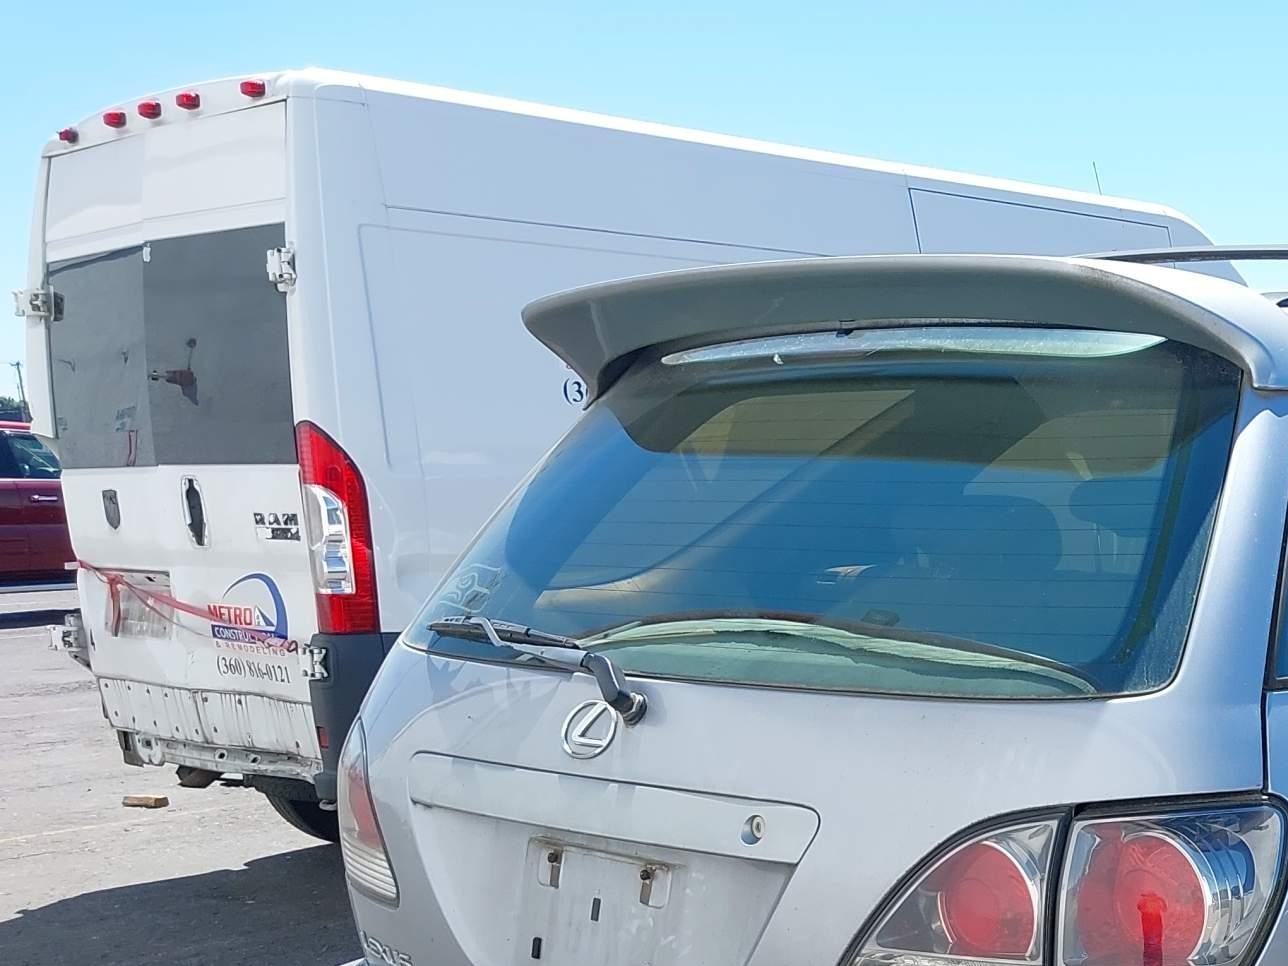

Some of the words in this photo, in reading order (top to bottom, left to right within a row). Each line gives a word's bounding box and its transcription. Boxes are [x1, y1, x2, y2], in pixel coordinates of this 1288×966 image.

[563, 377, 588, 405] (3
[253, 512, 299, 526] RAM
[207, 604, 253, 626] METRO
[216, 655, 247, 679] (360)
[245, 659, 291, 684] 816-0121
